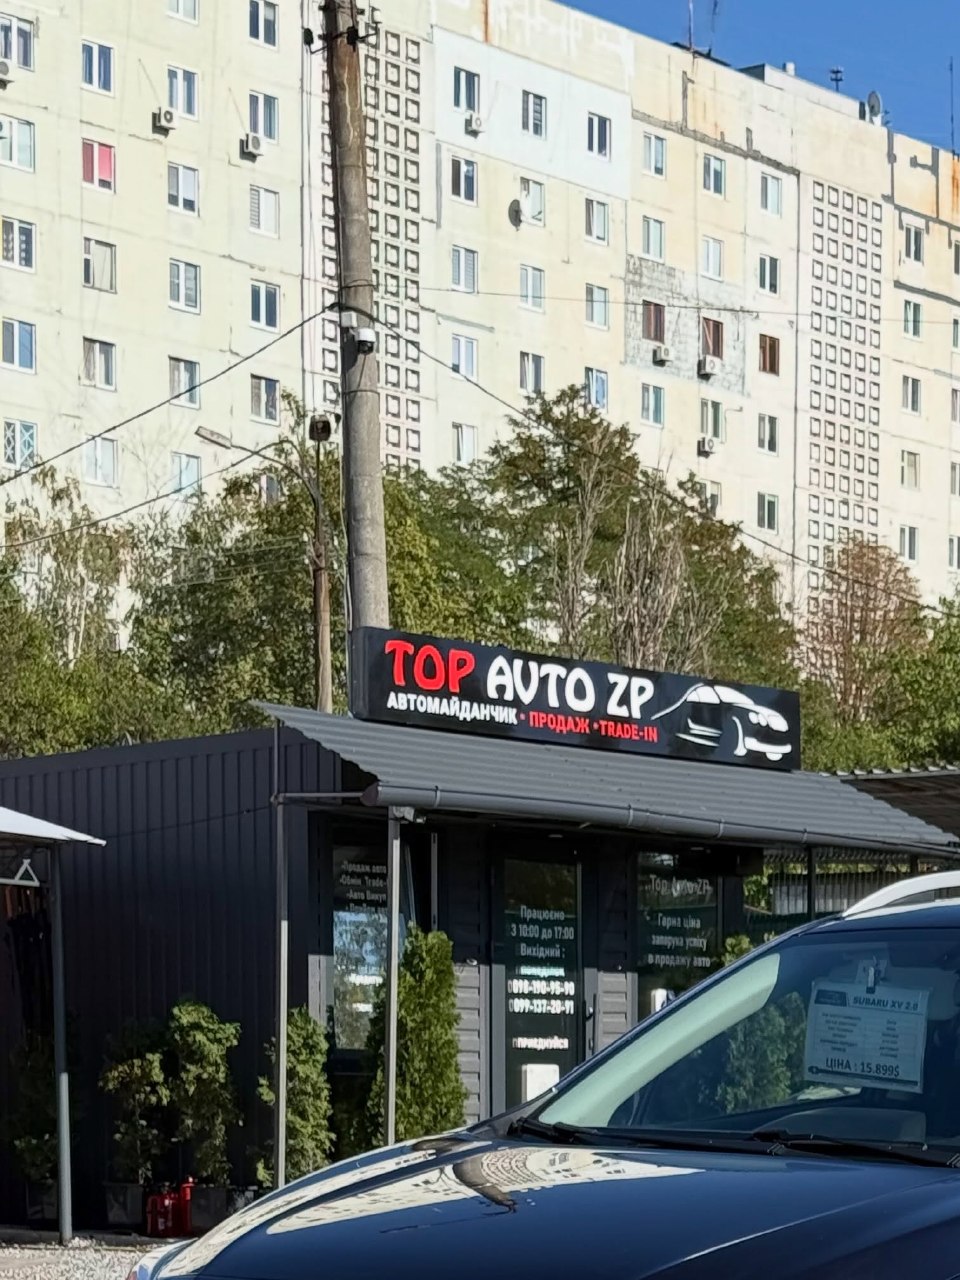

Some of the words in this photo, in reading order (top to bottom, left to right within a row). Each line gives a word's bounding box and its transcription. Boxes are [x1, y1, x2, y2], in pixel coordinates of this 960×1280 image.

[385, 640, 475, 693] TOP
[487, 655, 596, 712] AVTO
[607, 672, 654, 719] ZP
[387, 691, 518, 725] АВТОМАЙДАНЧИК
[529, 711, 590, 734] ПРОДАЖ
[600, 719, 658, 743] TRADE-IN
[852, 996, 889, 1008] SUBARU
[825, 1057, 852, 1072] ЦІНА
